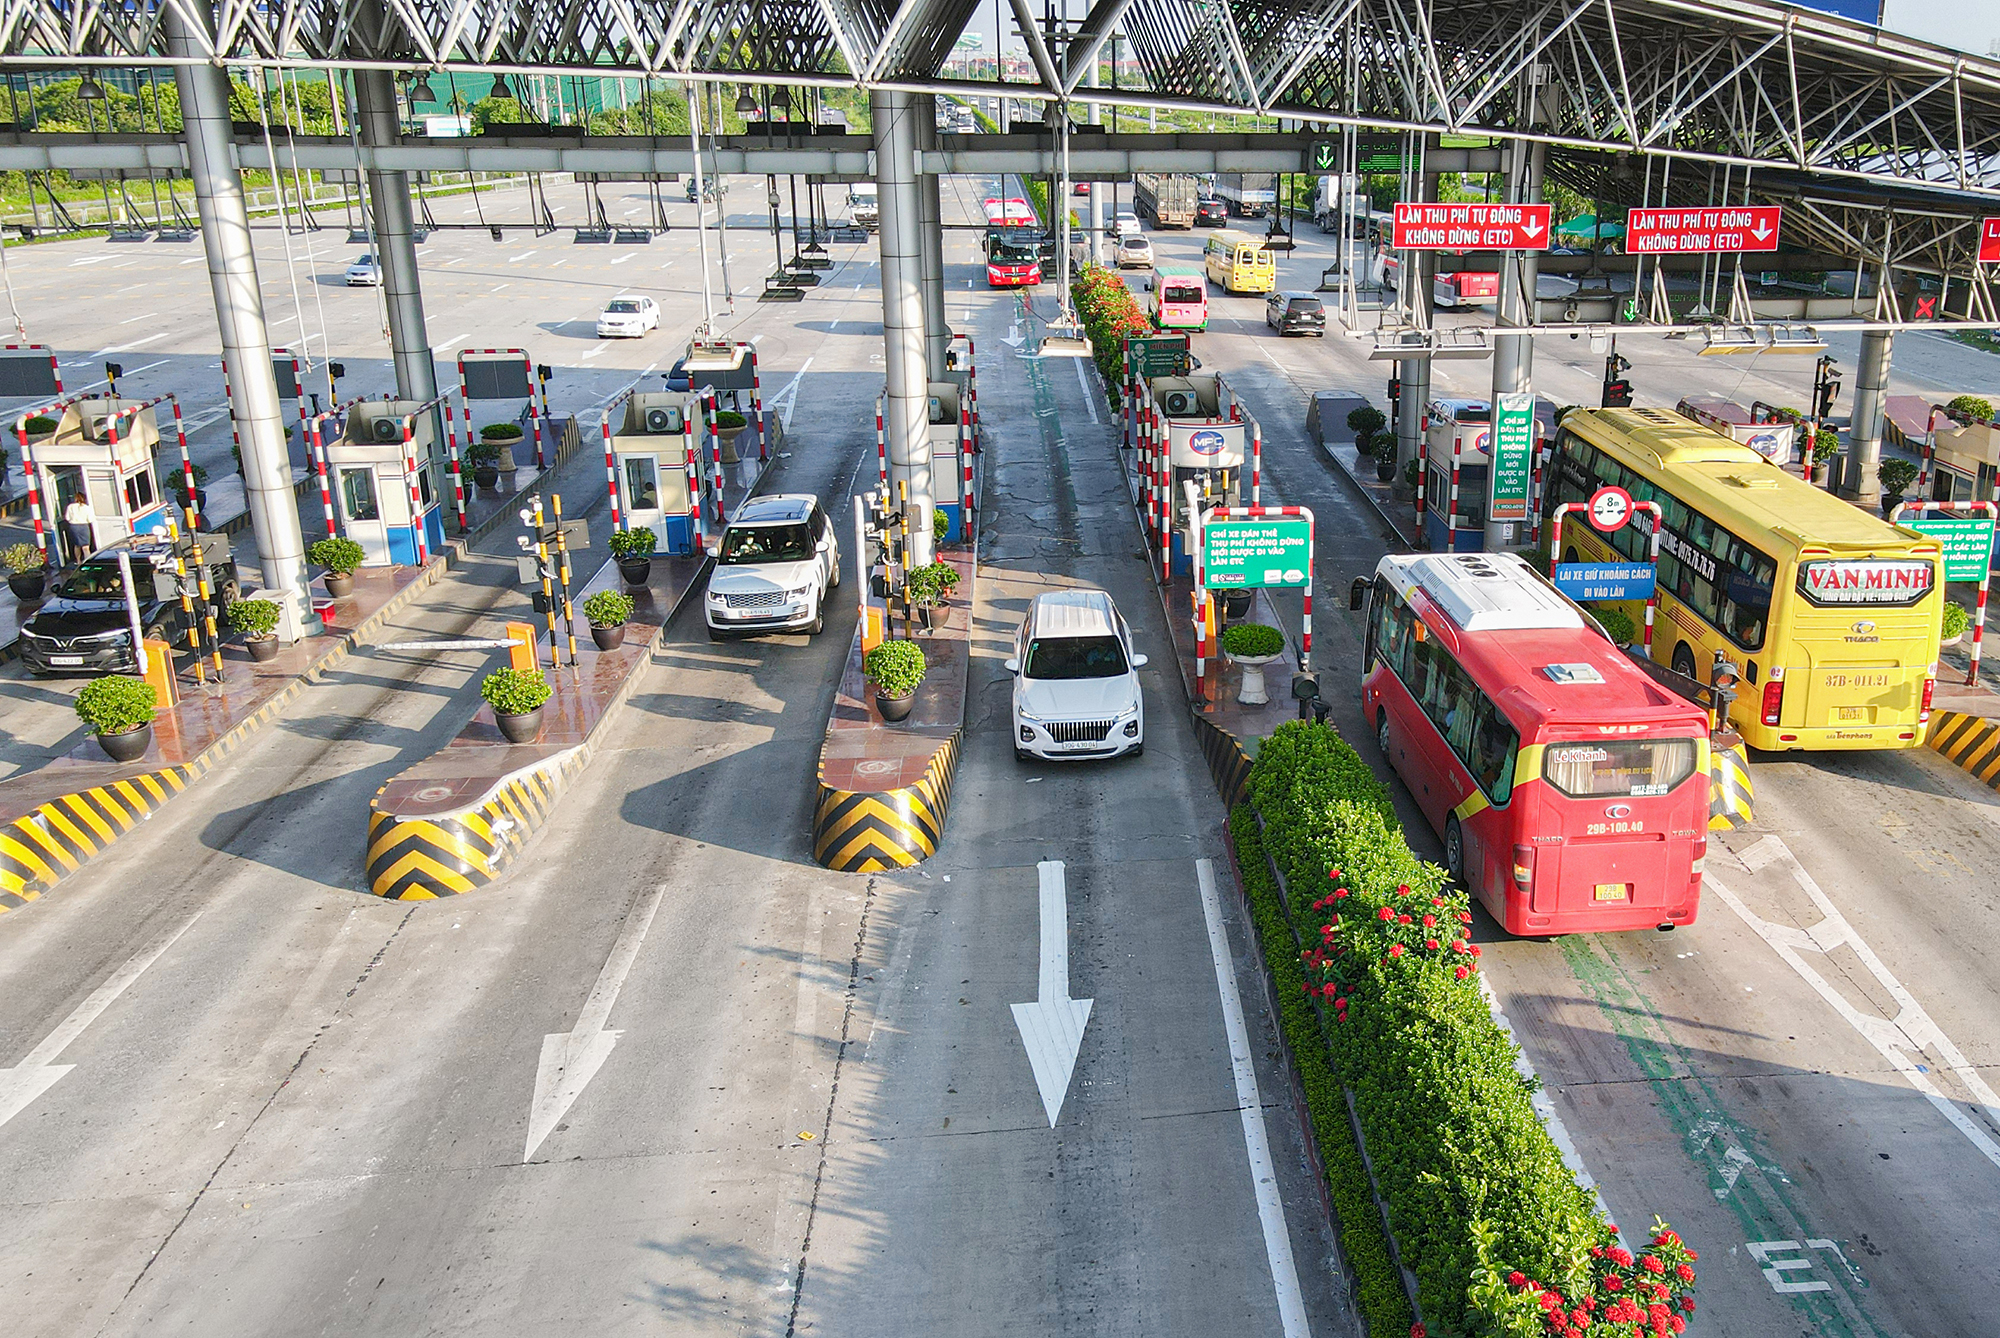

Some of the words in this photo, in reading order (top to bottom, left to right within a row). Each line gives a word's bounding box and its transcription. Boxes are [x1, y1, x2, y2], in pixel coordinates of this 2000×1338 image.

[1400, 205, 1422, 224] LÀN
[1425, 208, 1448, 224] THU
[1450, 205, 1472, 224] PHÍ
[1472, 208, 1488, 226] TỰ
[1490, 206, 1522, 226] ĐỘNG
[1633, 212, 1654, 230] LÀN
[1658, 213, 1680, 229] THU
[1682, 210, 1702, 228] PHÍ
[1704, 212, 1720, 230] TỰ
[1720, 210, 1752, 230] ĐỘNG
[1405, 227, 1445, 244] KHÔNG
[1448, 226, 1480, 244] DỪNG
[1483, 228, 1514, 245] (ETC)
[1638, 232, 1677, 250] KHÔNG
[1680, 231, 1710, 249] DỪNG
[1714, 233, 1744, 249] (ETC)
[1194, 436, 1223, 447] MPC
[1230, 538, 1245, 547] PHÍ
[1247, 538, 1278, 547] KHÔNG
[1268, 547, 1286, 555] VÀO
[1211, 557, 1228, 566] LÀN
[1560, 568, 1571, 580] LÁI
[1573, 570, 1582, 580] XE
[1584, 568, 1598, 580] GIỮ
[1599, 566, 1630, 580] KHOẢNG
[1631, 567, 1651, 579] CÁCH
[1808, 563, 1860, 589] VĂN
[1864, 568, 1930, 589] MINH
[1584, 588, 1592, 597] ĐI
[1594, 585, 1608, 597] VÀO
[1610, 585, 1624, 596] LÀN
[1878, 592, 1892, 601] 1900
[1598, 725, 1649, 734] VIP
[1554, 750, 1569, 763] Lê
[1587, 822, 1643, 835] 29B-100.40
